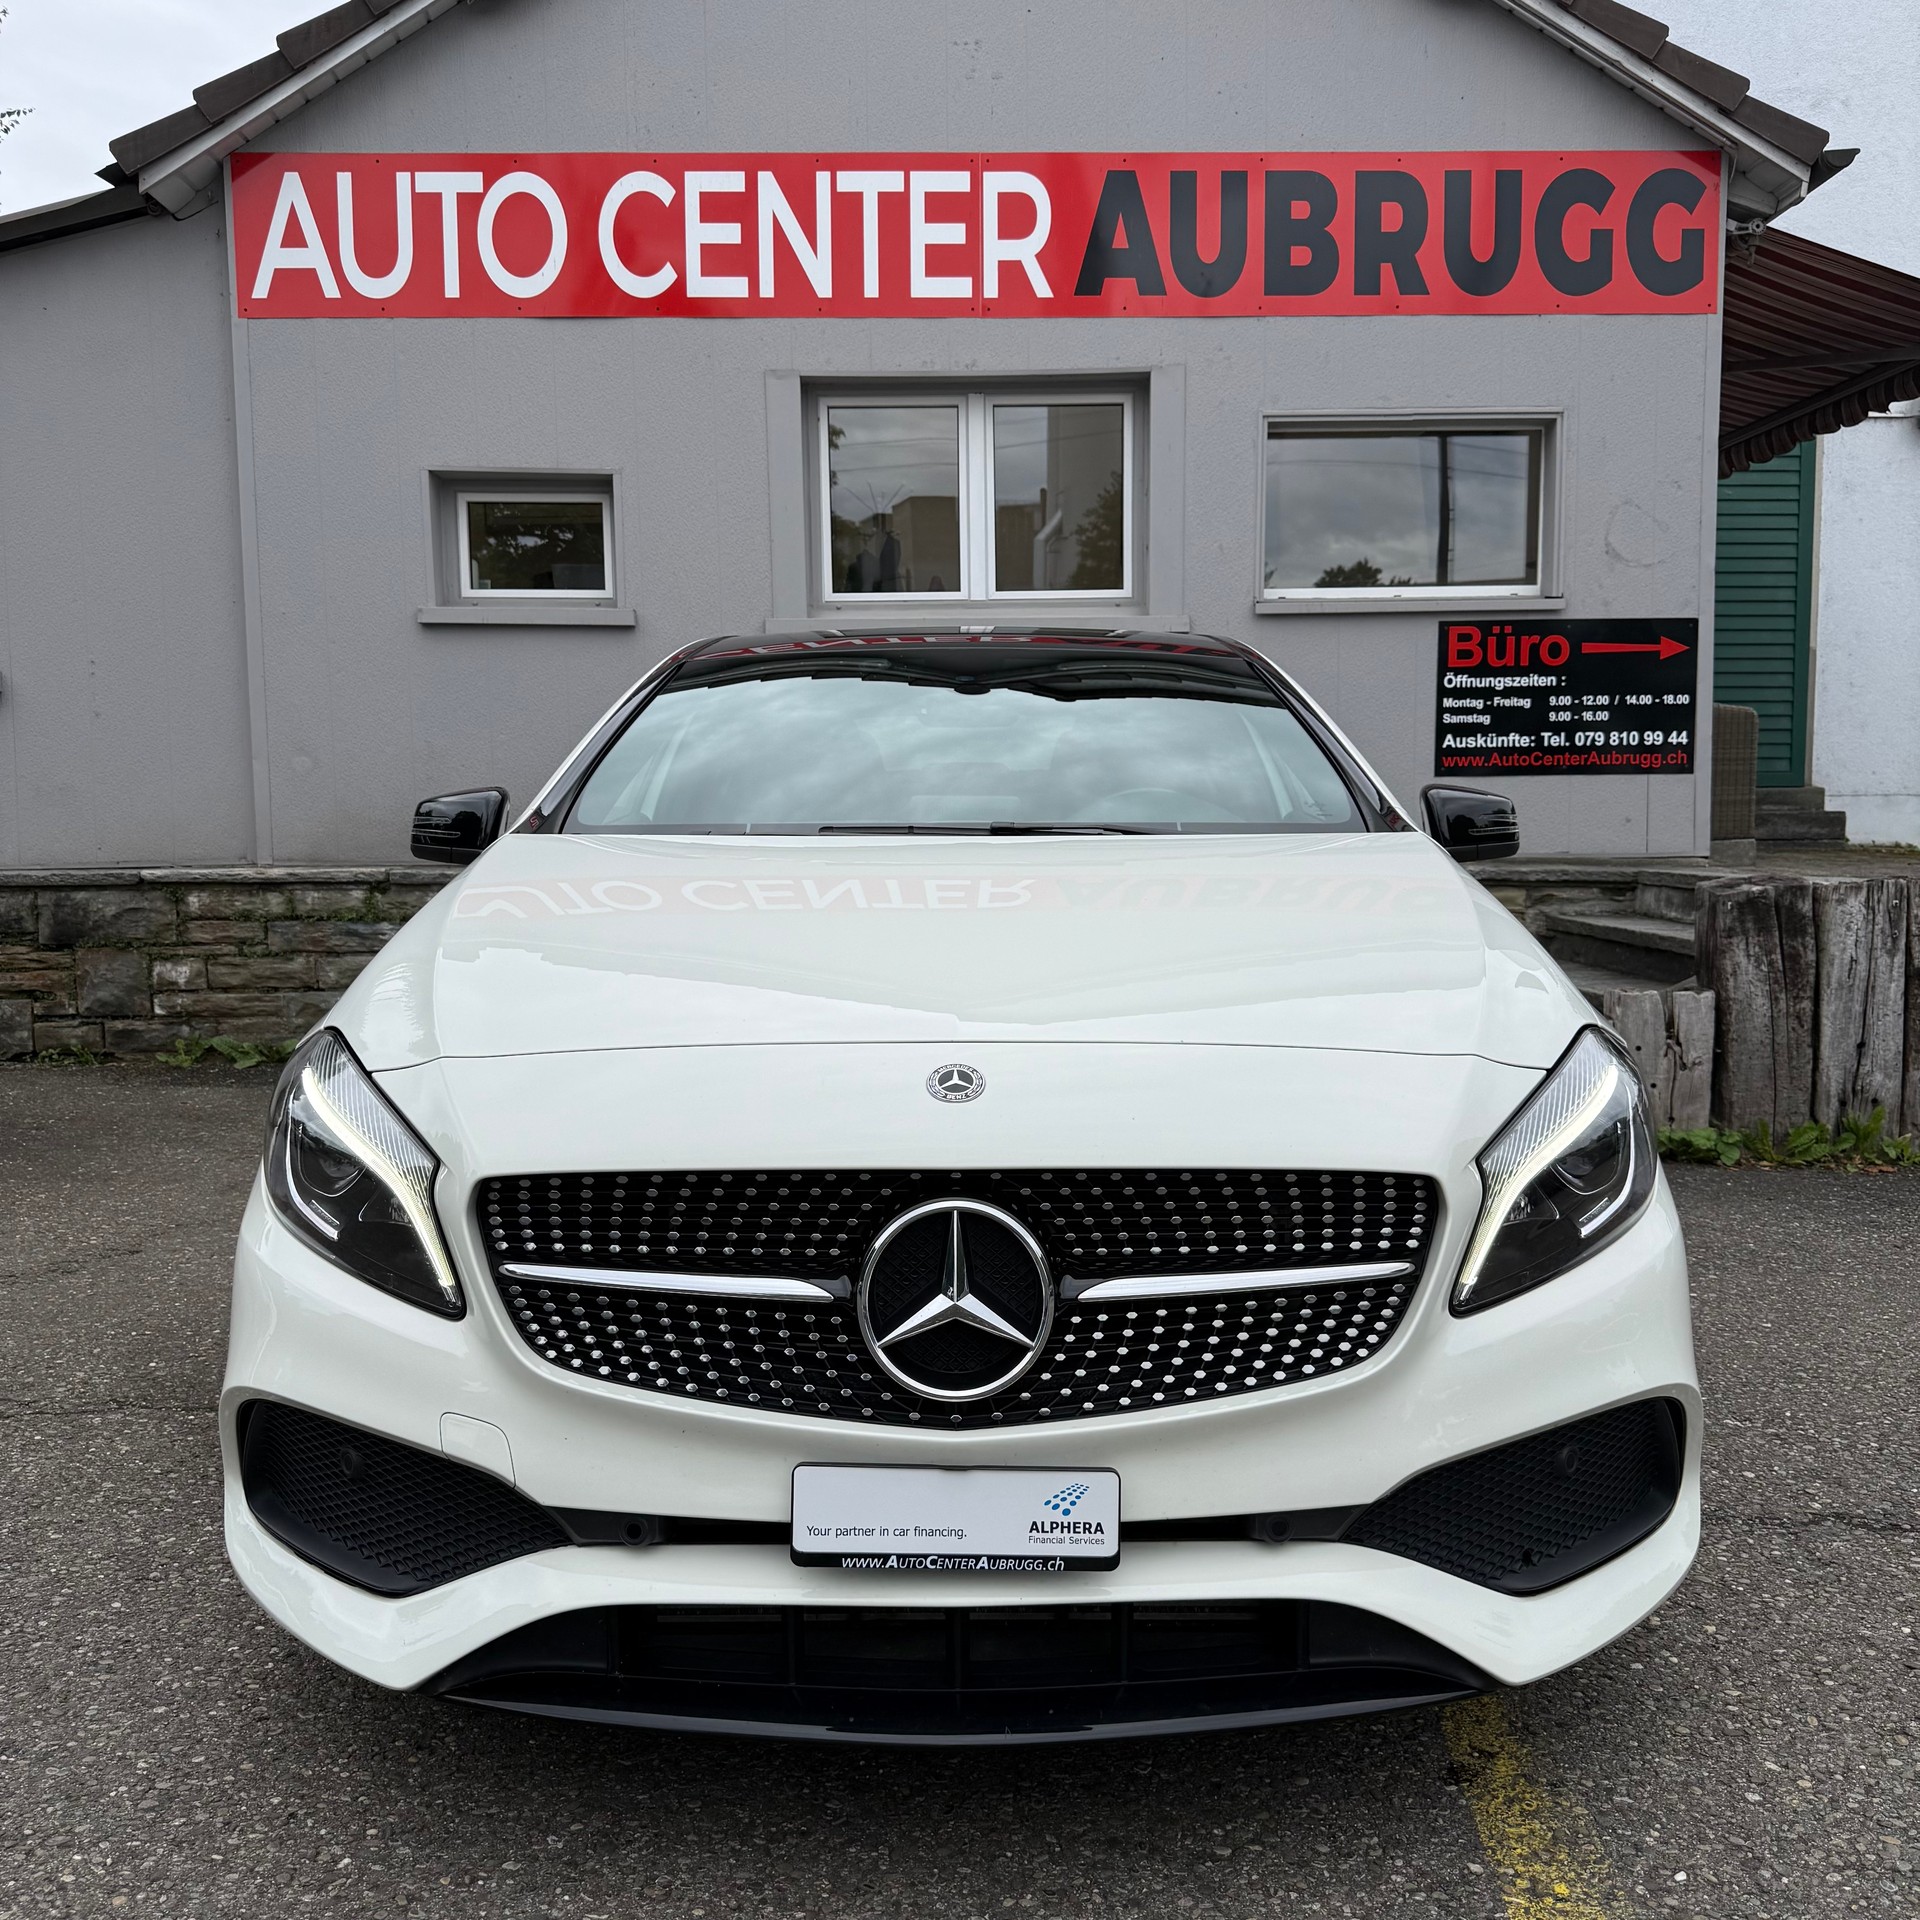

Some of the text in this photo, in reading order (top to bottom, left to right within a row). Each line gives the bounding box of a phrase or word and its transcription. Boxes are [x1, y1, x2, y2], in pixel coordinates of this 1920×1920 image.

[251, 167, 1708, 300] AUTO CENTER AUBRUGG
[1447, 625, 1570, 668] Büro
[1443, 672, 1557, 690] Öffnungszeiten
[1442, 697, 1484, 709] Montag
[1493, 696, 1531, 709] Freitag
[1549, 695, 1571, 706] 9.00
[1581, 695, 1609, 706] 12.00
[1625, 694, 1652, 705] 14.00
[1663, 694, 1690, 705] 18.00
[1442, 713, 1491, 725] Samstag
[1549, 711, 1571, 722] 9.00
[1581, 711, 1609, 722] 16.00
[1442, 730, 1688, 749] Auskünfte: Tel. 079 810 99 44
[1442, 750, 1688, 769] www.AutoCenterAubrugg.ch
[806, 1525, 967, 1540] Your partner in car financing.
[1028, 1520, 1105, 1535] ALPHERA
[1028, 1535, 1105, 1546] Financial Services
